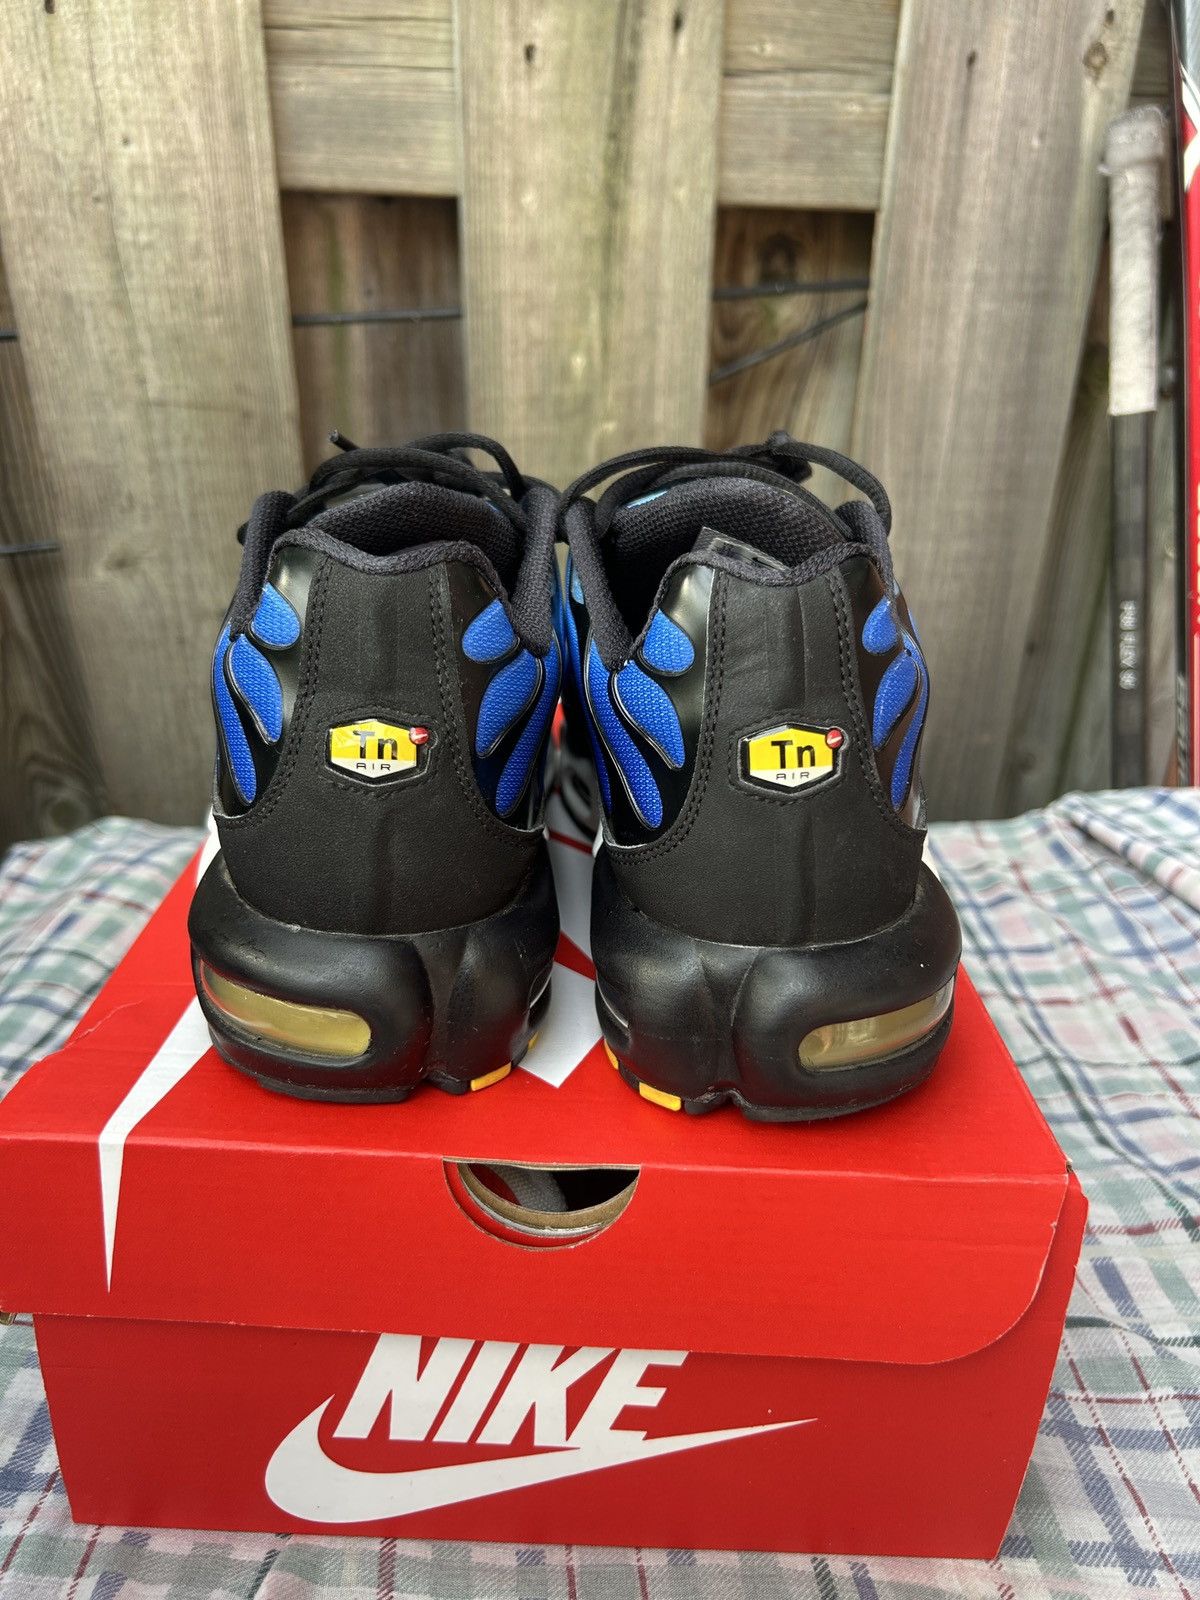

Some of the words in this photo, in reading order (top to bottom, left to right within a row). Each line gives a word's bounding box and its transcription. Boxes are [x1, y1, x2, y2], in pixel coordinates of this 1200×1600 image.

[352, 730, 398, 760] Tn
[770, 740, 815, 769] Tn
[356, 762, 391, 771] AIR
[776, 771, 811, 780] AIR
[332, 1333, 690, 1447] NIKE
